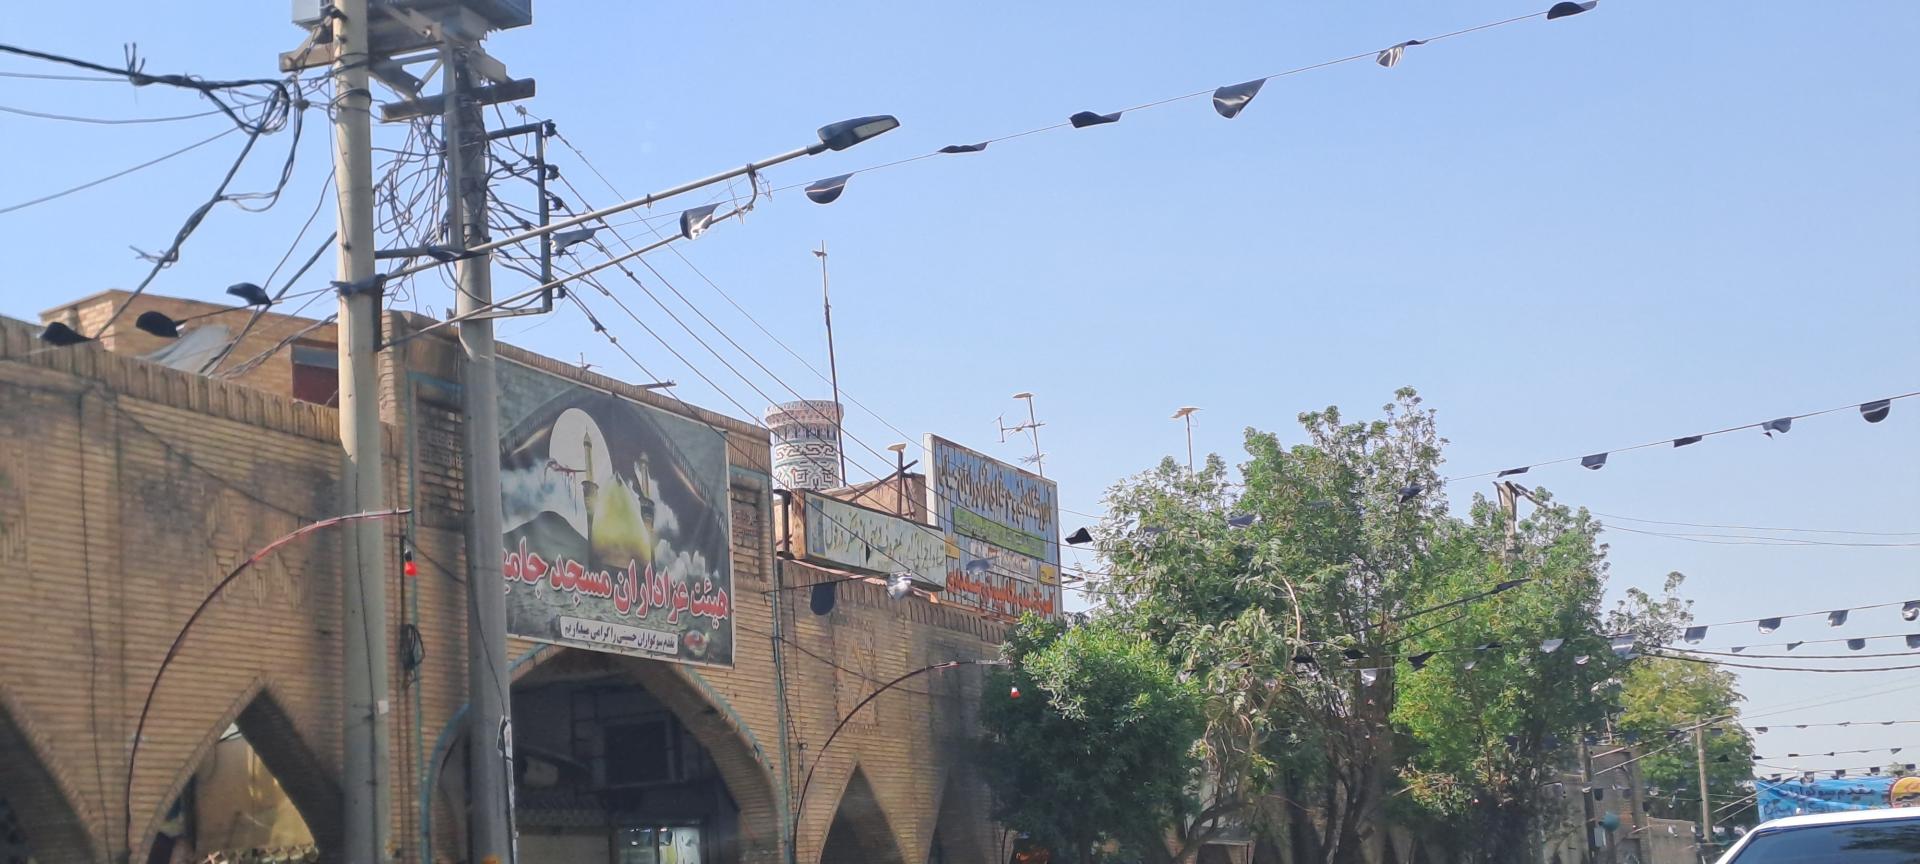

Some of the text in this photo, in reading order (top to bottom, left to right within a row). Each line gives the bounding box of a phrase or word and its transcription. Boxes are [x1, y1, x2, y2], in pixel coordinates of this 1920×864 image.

[550, 554, 611, 607] مسجد
[614, 559, 689, 624] عزاداران
[691, 577, 728, 629] هیئت
[638, 632, 662, 649] سوگواران
